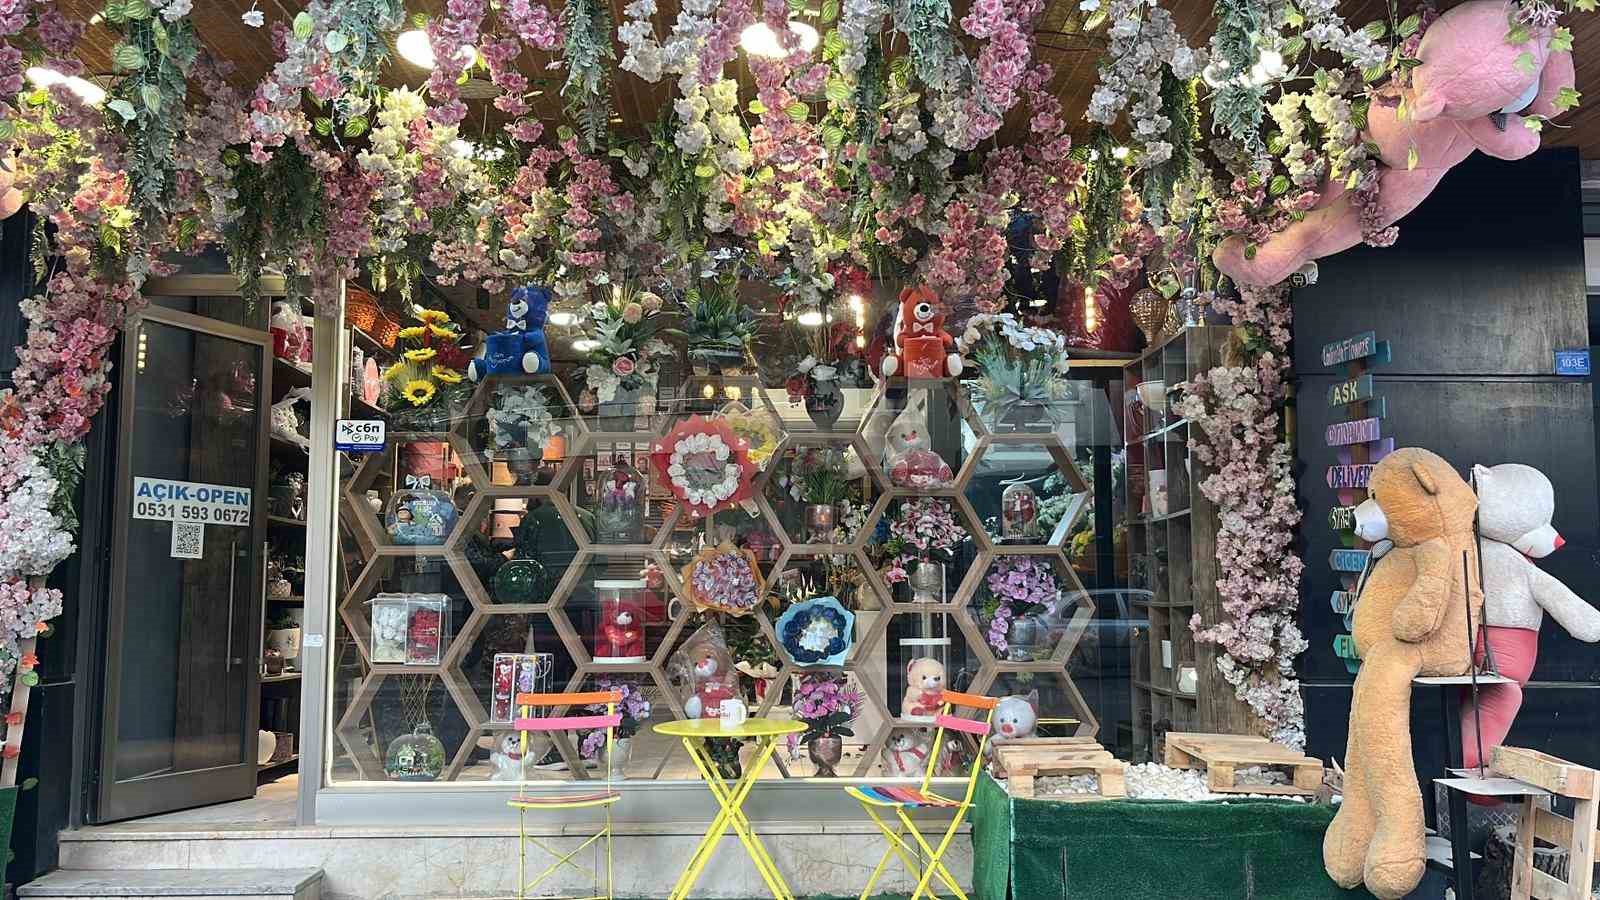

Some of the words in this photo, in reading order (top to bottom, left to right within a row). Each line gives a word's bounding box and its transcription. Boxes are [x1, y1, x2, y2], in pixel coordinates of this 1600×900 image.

[1561, 358, 1585, 368] 103E
[364, 434, 379, 443] Pay
[137, 482, 249, 506] AÇIK-OPEN
[137, 502, 175, 518] 0531
[182, 505, 208, 520] 593
[214, 508, 249, 523] 0672
